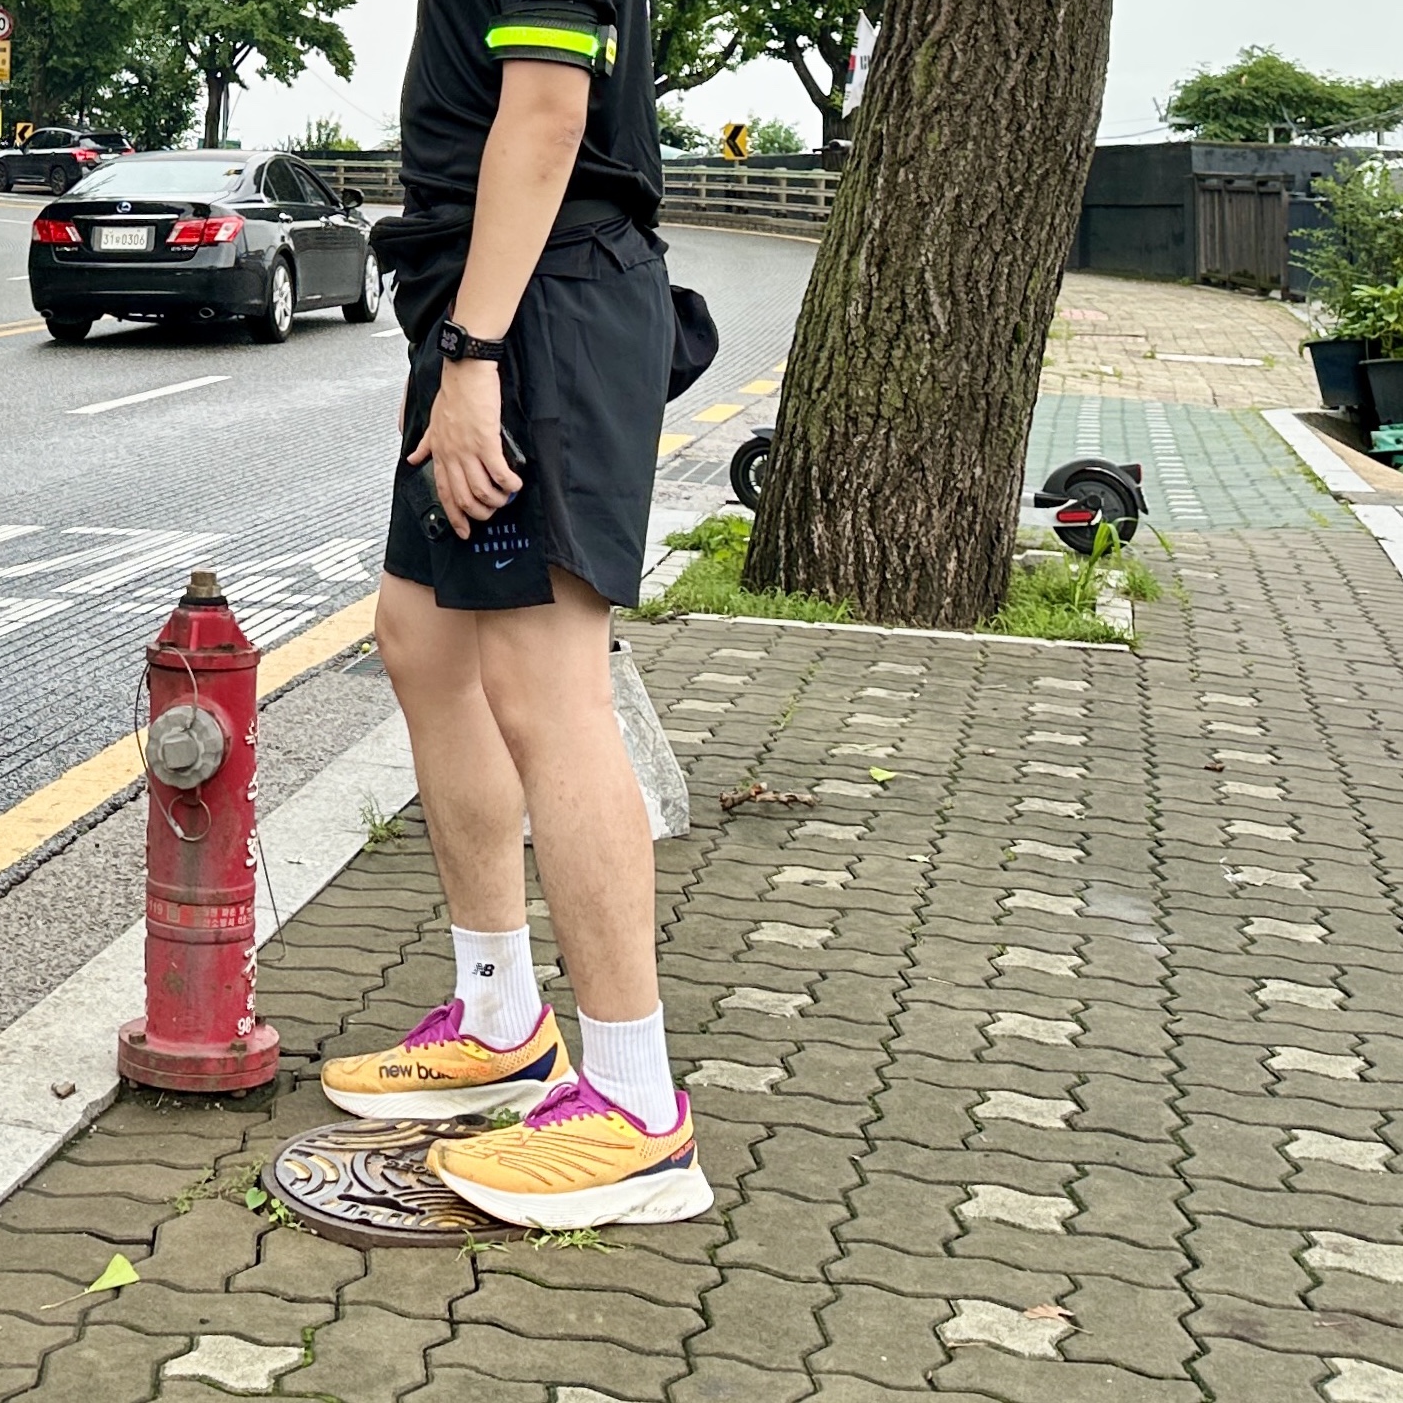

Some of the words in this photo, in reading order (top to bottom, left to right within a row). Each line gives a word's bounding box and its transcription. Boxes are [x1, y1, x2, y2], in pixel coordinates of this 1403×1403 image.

[487, 523, 517, 536] NIKE
[474, 538, 529, 553] RUNNING
[379, 1063, 413, 1079] new
